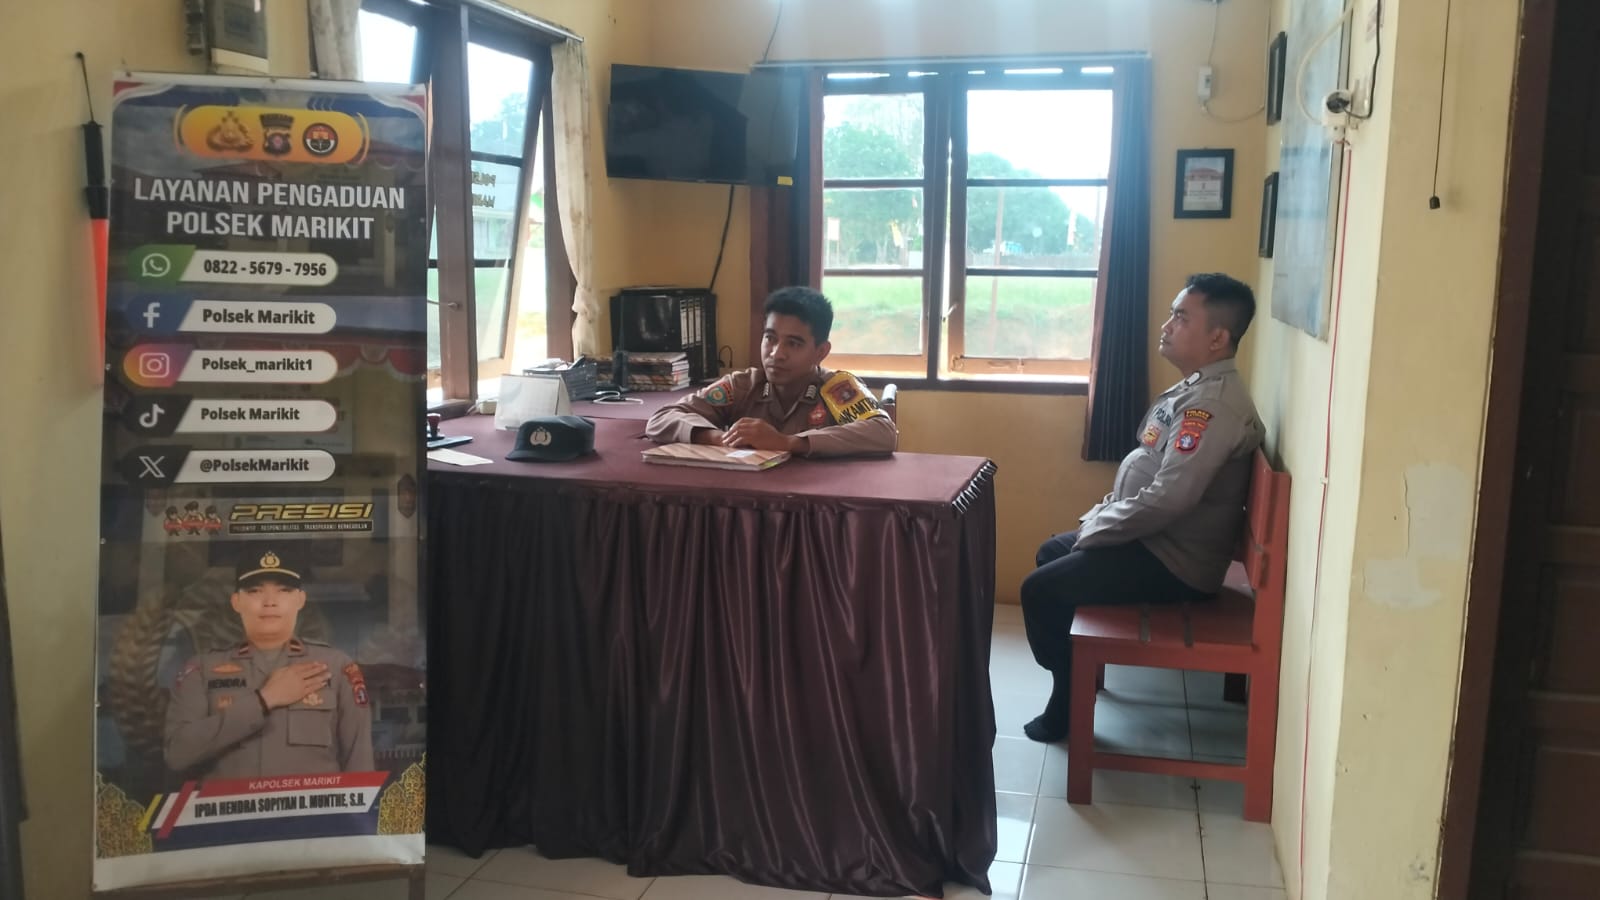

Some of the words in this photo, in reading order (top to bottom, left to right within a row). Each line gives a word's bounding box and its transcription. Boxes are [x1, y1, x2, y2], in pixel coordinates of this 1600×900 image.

[134, 177, 250, 204] LAYANAN
[258, 183, 405, 209] PENGADUAN
[166, 211, 264, 237] POLSEK
[271, 215, 375, 239] MARIKIT
[203, 258, 237, 274] 0822
[249, 260, 283, 275] 5679
[294, 261, 327, 277] 7956
[202, 309, 254, 324] Polsek
[257, 309, 315, 325] Marikit
[201, 357, 313, 373] Polsek_marikit1
[201, 408, 246, 420] Polsek
[249, 408, 300, 420] Marikit
[200, 458, 310, 473] @PolsekMarikit
[230, 503, 374, 520] PRESISI
[248, 778, 301, 790] KAPOLSEK
[303, 776, 342, 787] MARIKIT
[194, 802, 217, 818] IPDA
[219, 798, 257, 816] HENDRA
[258, 796, 297, 813] SOPIYAN
[309, 793, 349, 809] MUNTHE,
